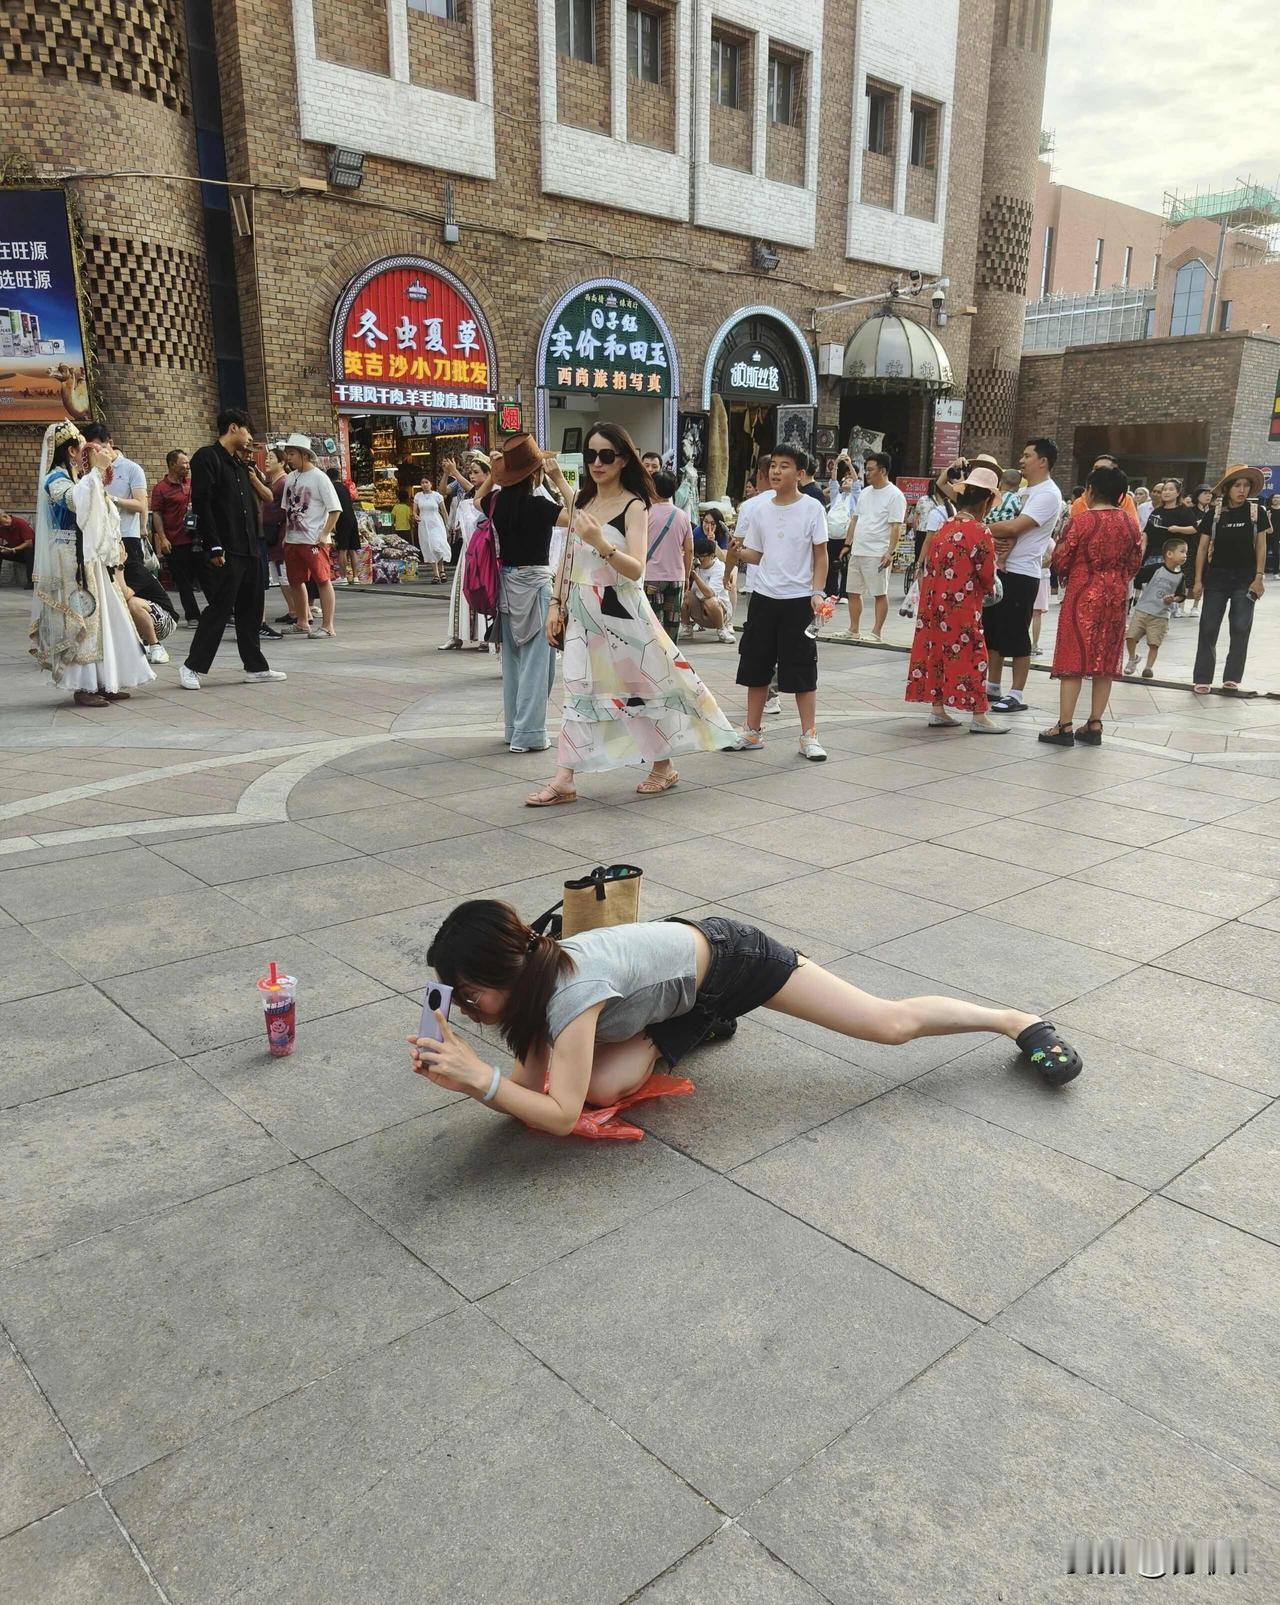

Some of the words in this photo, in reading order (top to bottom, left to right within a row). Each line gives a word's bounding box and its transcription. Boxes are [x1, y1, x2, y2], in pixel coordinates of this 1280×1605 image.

[352, 308, 480, 357] 冬虫夏草
[550, 324, 667, 367] 实价和田玉
[344, 350, 487, 384] 英吉沙小刀批发
[557, 367, 661, 392] 西尚旅拍写真
[730, 361, 779, 391] 波斯丝毯
[502, 406, 519, 430] 烟
